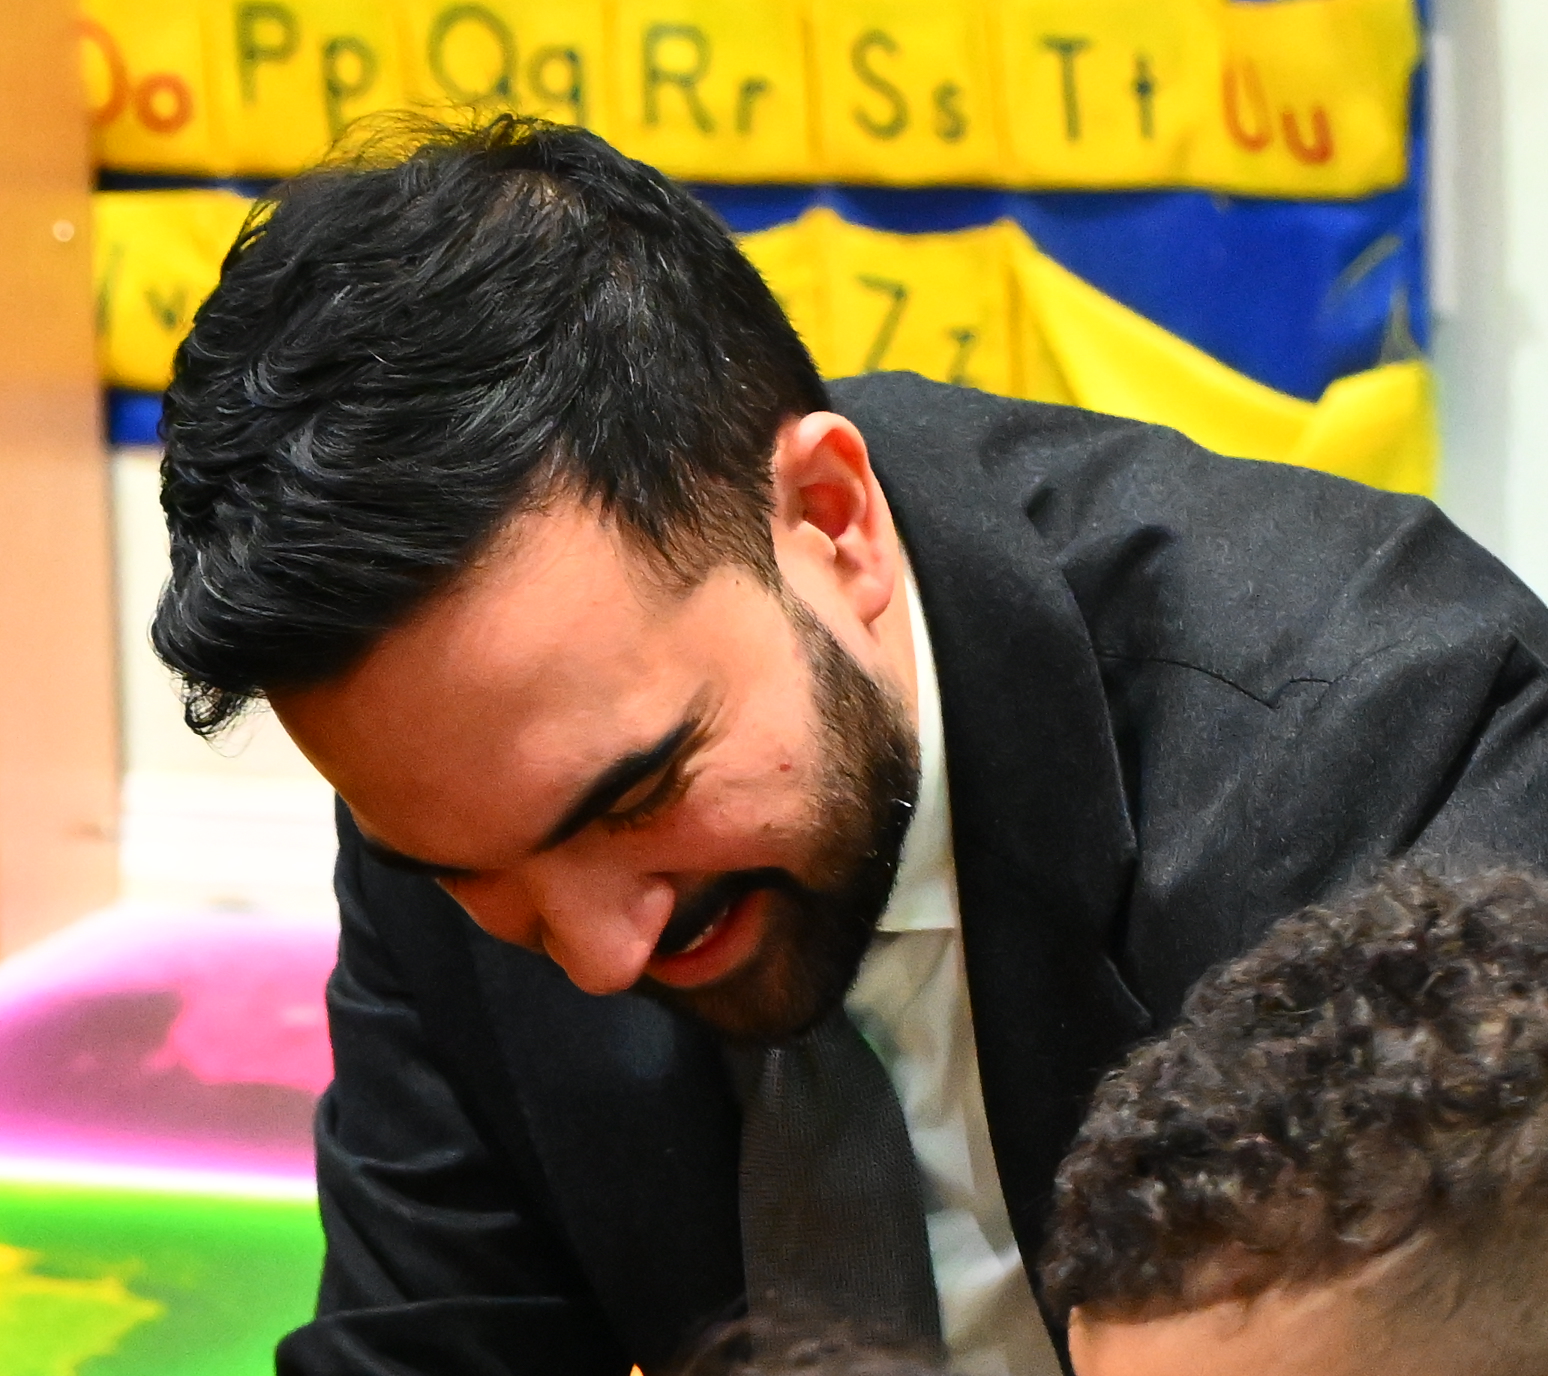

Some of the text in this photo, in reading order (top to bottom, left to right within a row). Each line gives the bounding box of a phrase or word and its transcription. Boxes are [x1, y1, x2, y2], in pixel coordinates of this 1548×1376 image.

[235, 2, 378, 147] Pp
[640, 23, 771, 135] Rr
[850, 29, 968, 143] Ss
[1042, 34, 1156, 141] Tt
[1221, 58, 1335, 165] Uu
